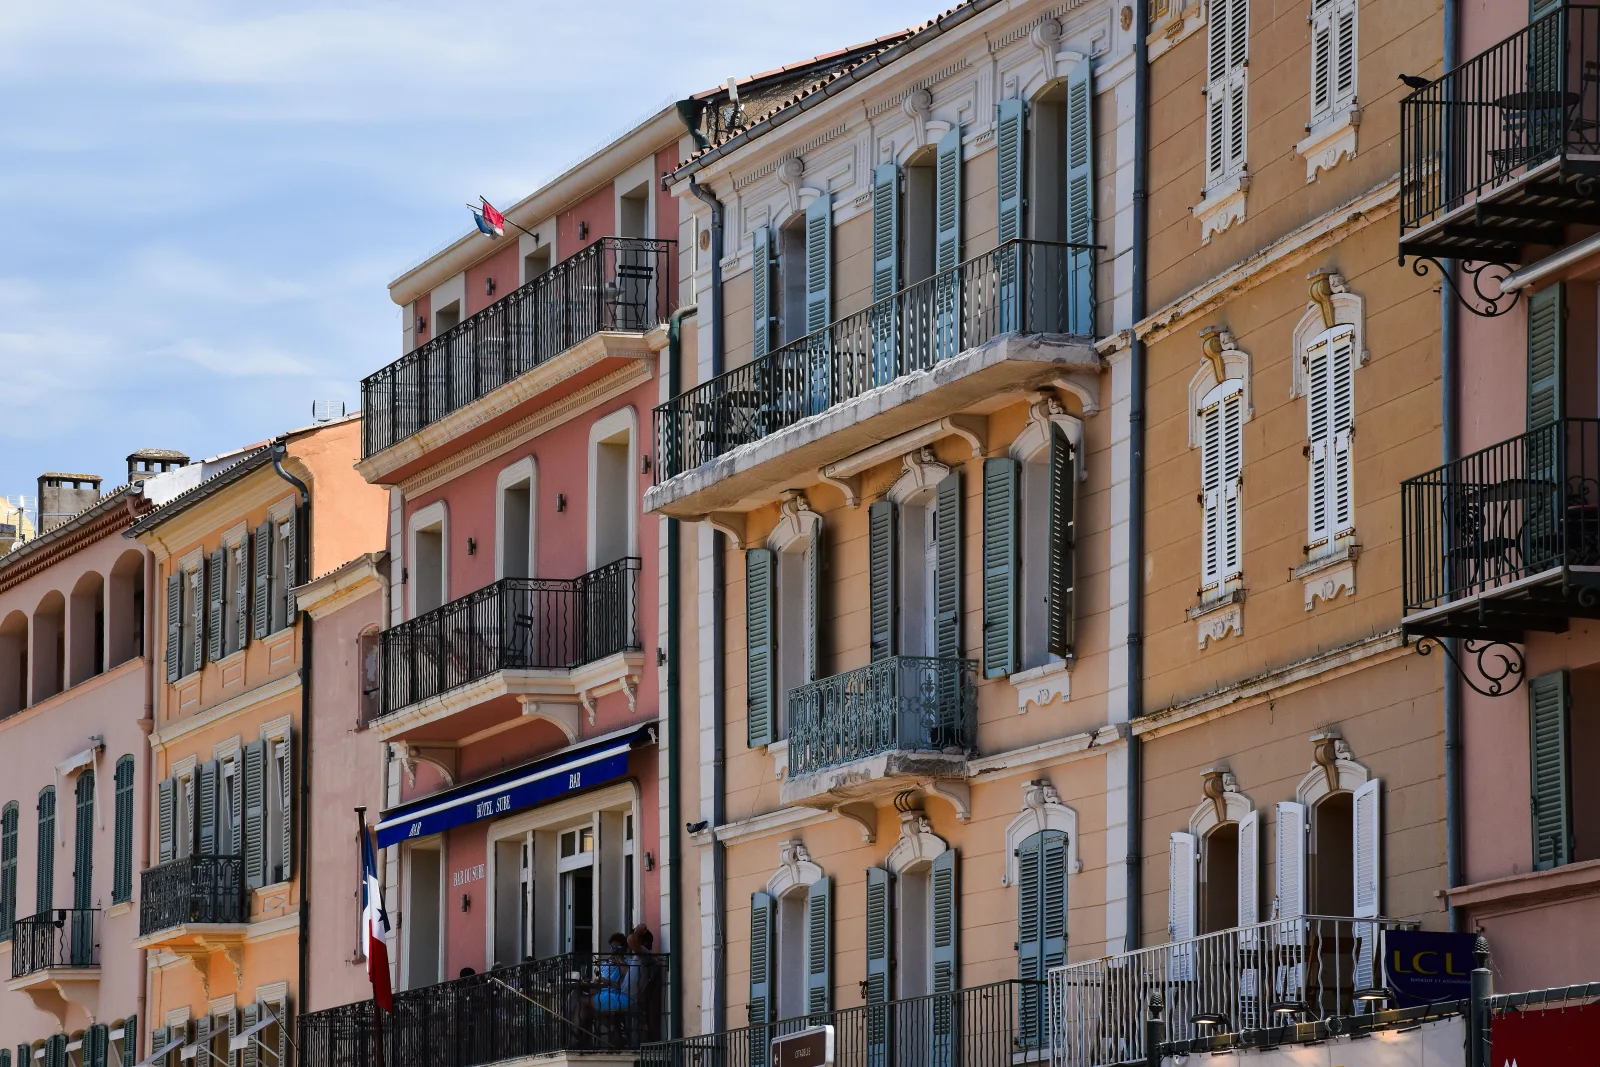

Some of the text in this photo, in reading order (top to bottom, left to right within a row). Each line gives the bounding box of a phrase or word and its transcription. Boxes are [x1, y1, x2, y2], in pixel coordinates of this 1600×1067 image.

[409, 822, 422, 837] BAR
[569, 772, 581, 789] BAR
[454, 870, 464, 887] BAR
[1393, 950, 1467, 976] LCL
